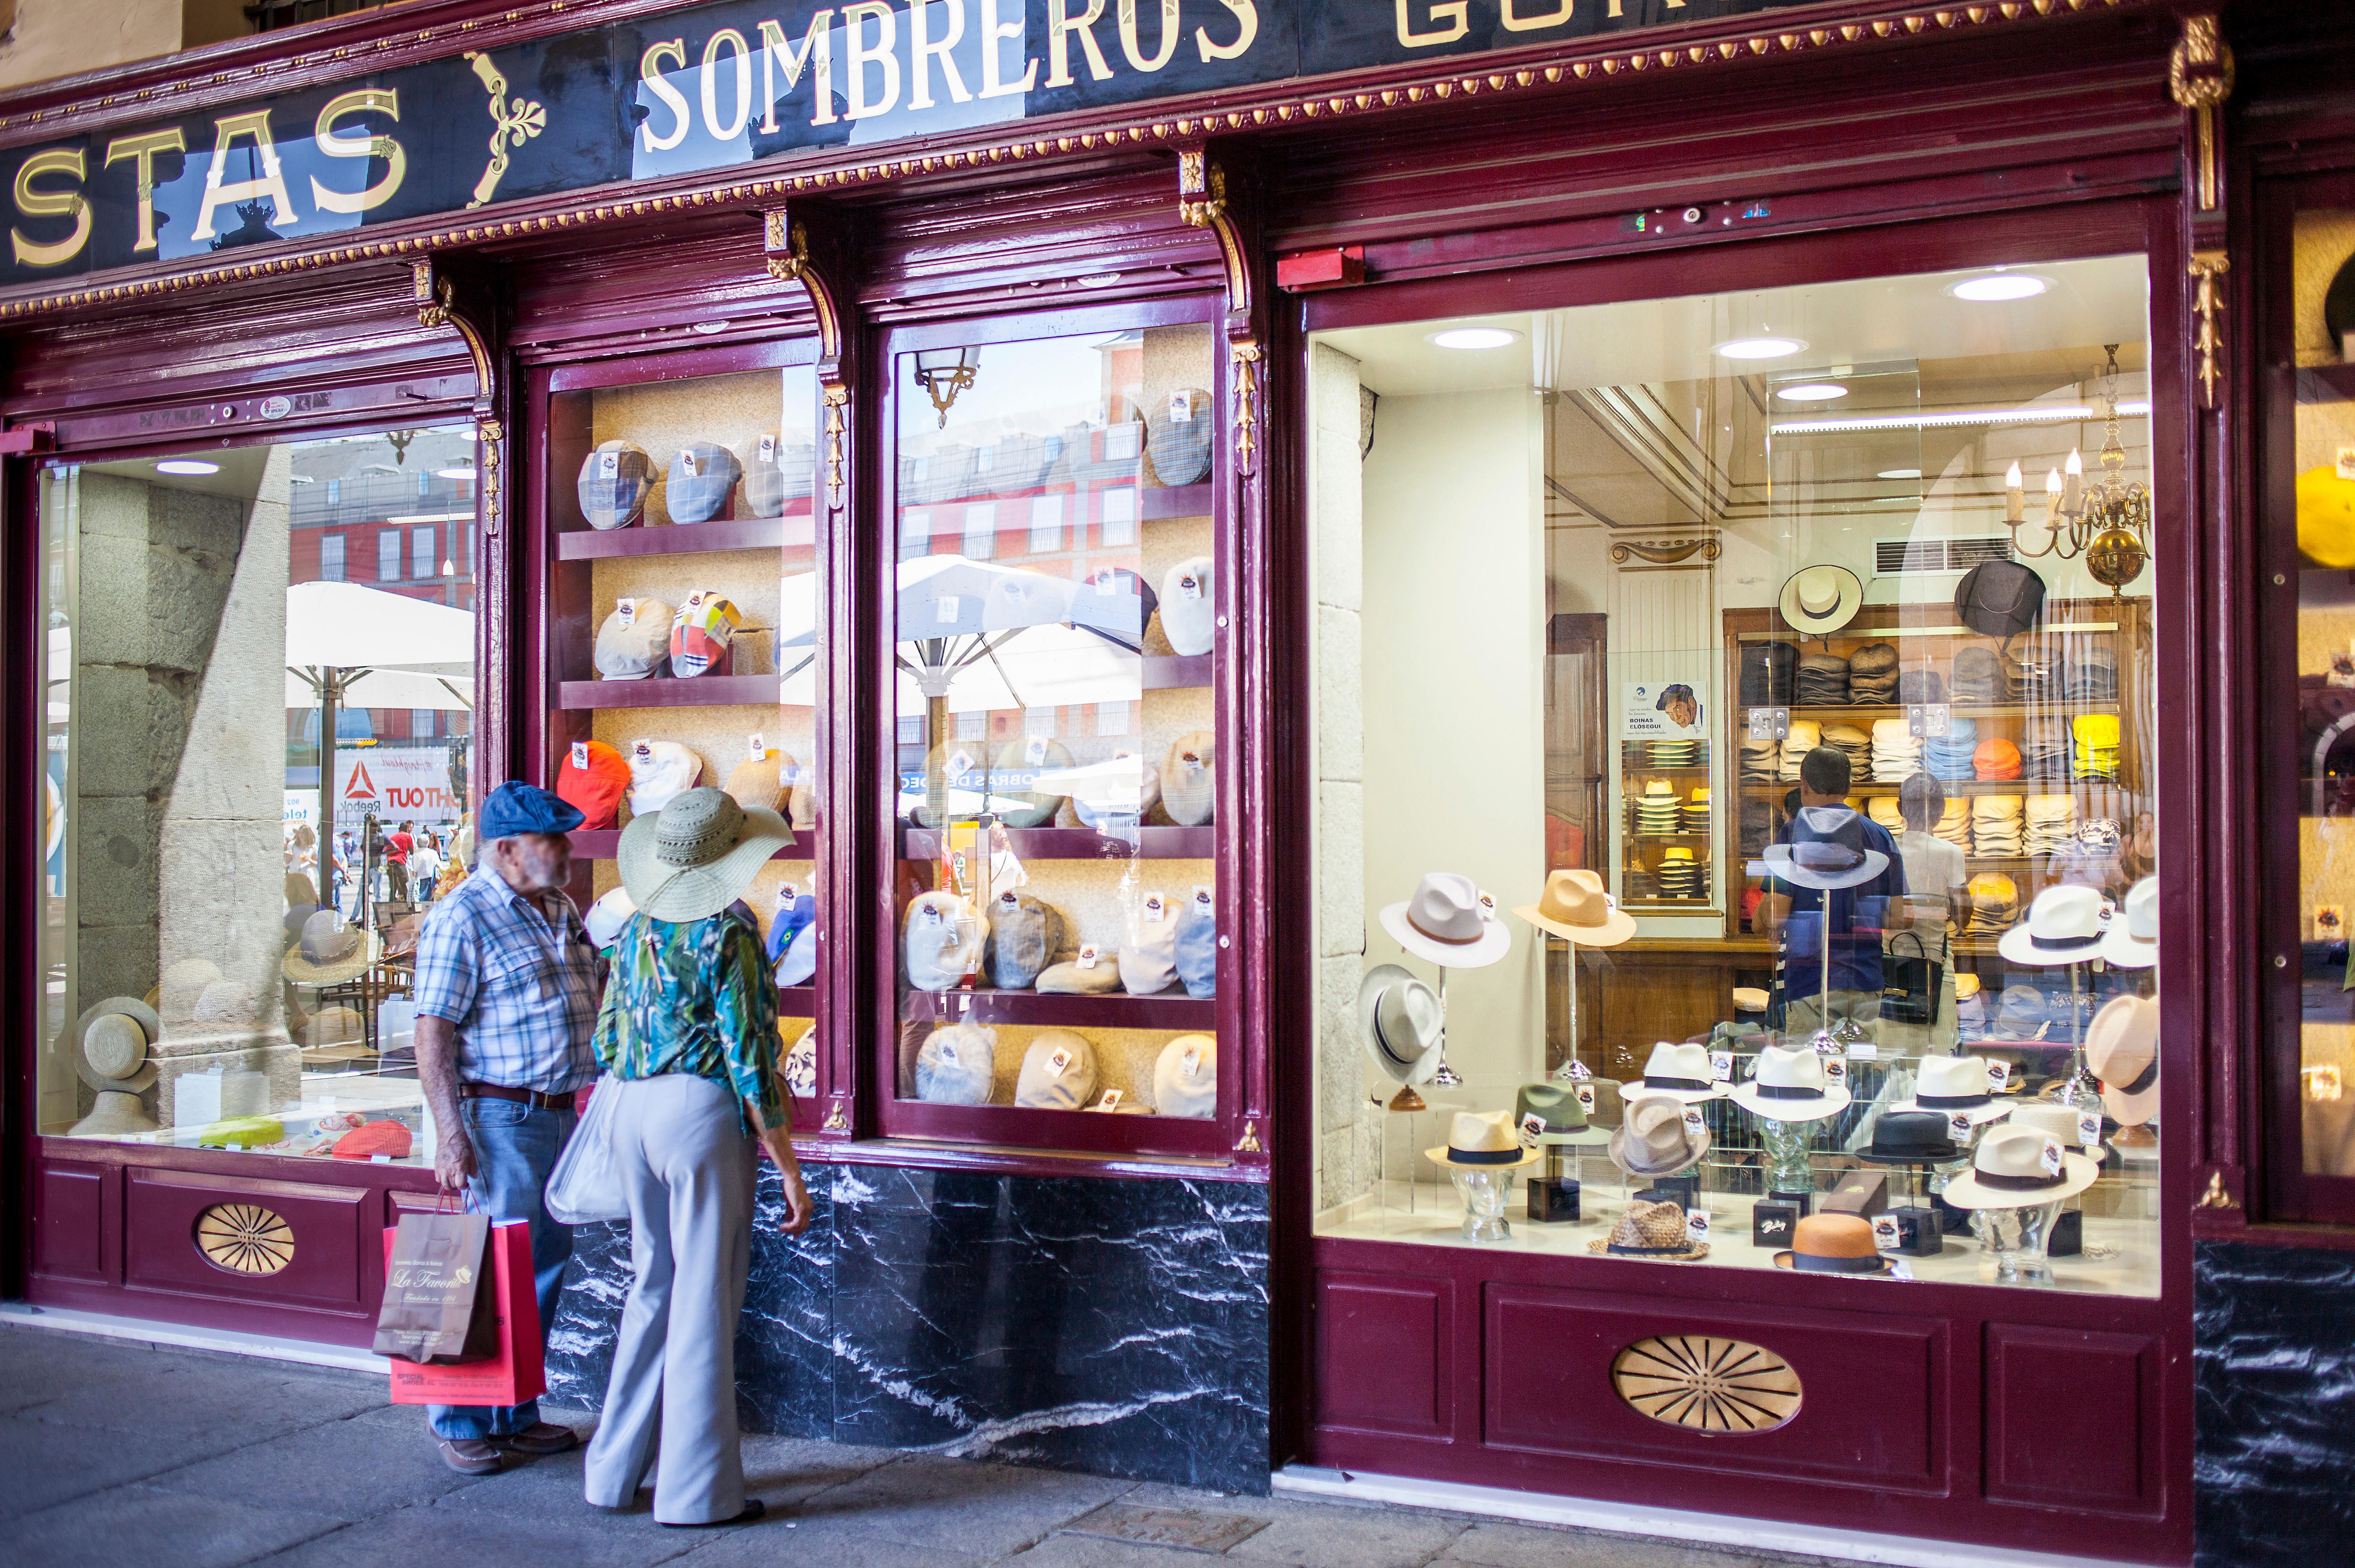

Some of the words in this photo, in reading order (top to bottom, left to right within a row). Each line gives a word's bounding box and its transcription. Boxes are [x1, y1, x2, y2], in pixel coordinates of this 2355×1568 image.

[640, 0, 1258, 153] SOMBREROS
[11, 88, 407, 267] STAS
[391, 1269, 412, 1288] La
[413, 1269, 461, 1288] Favorita
